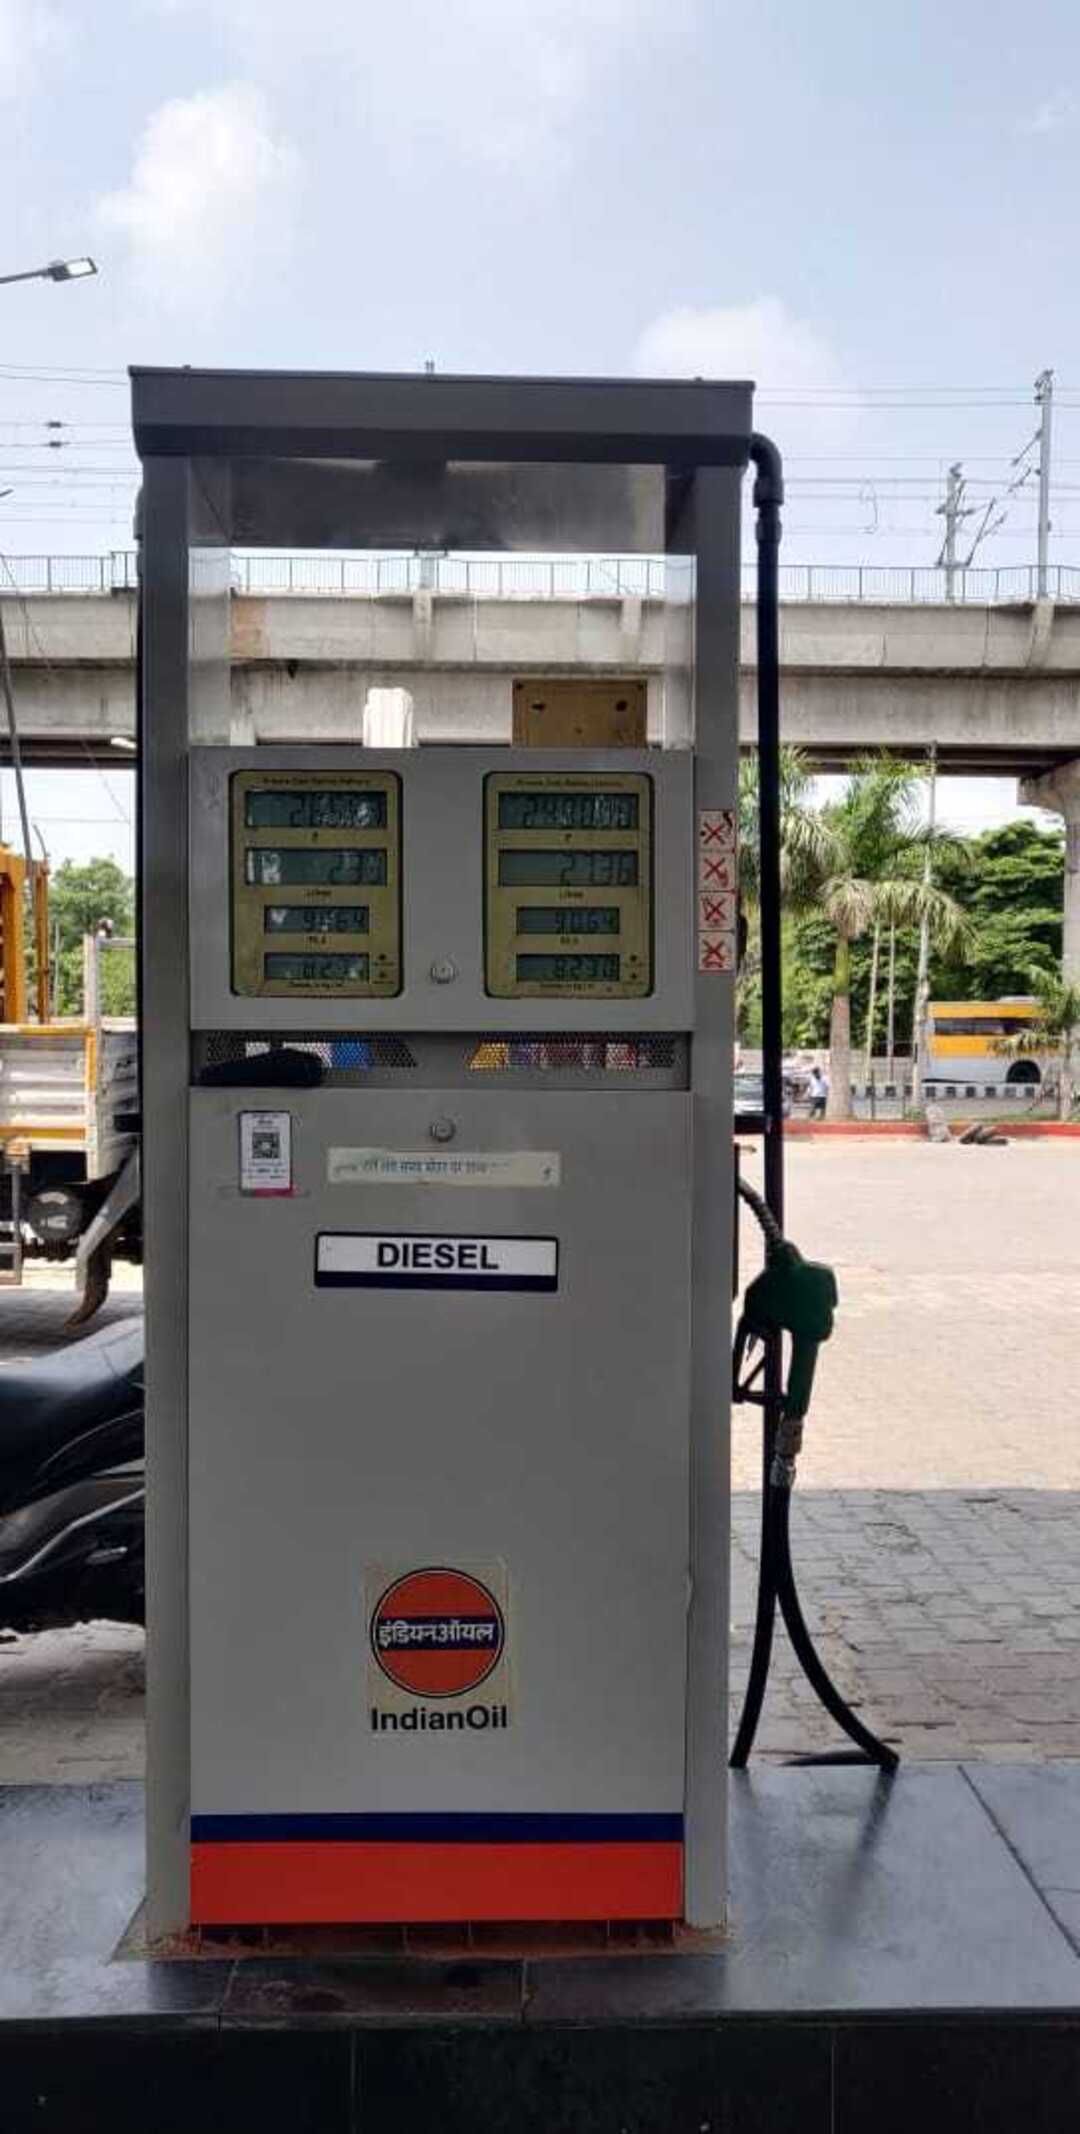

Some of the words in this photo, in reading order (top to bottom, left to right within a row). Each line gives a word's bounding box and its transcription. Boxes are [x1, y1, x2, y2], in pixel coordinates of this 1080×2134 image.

[377, 1242, 499, 1270] DIESEL
[378, 1618, 495, 1648] इंडियनऑयल
[371, 1705, 507, 1730] IndianOil
